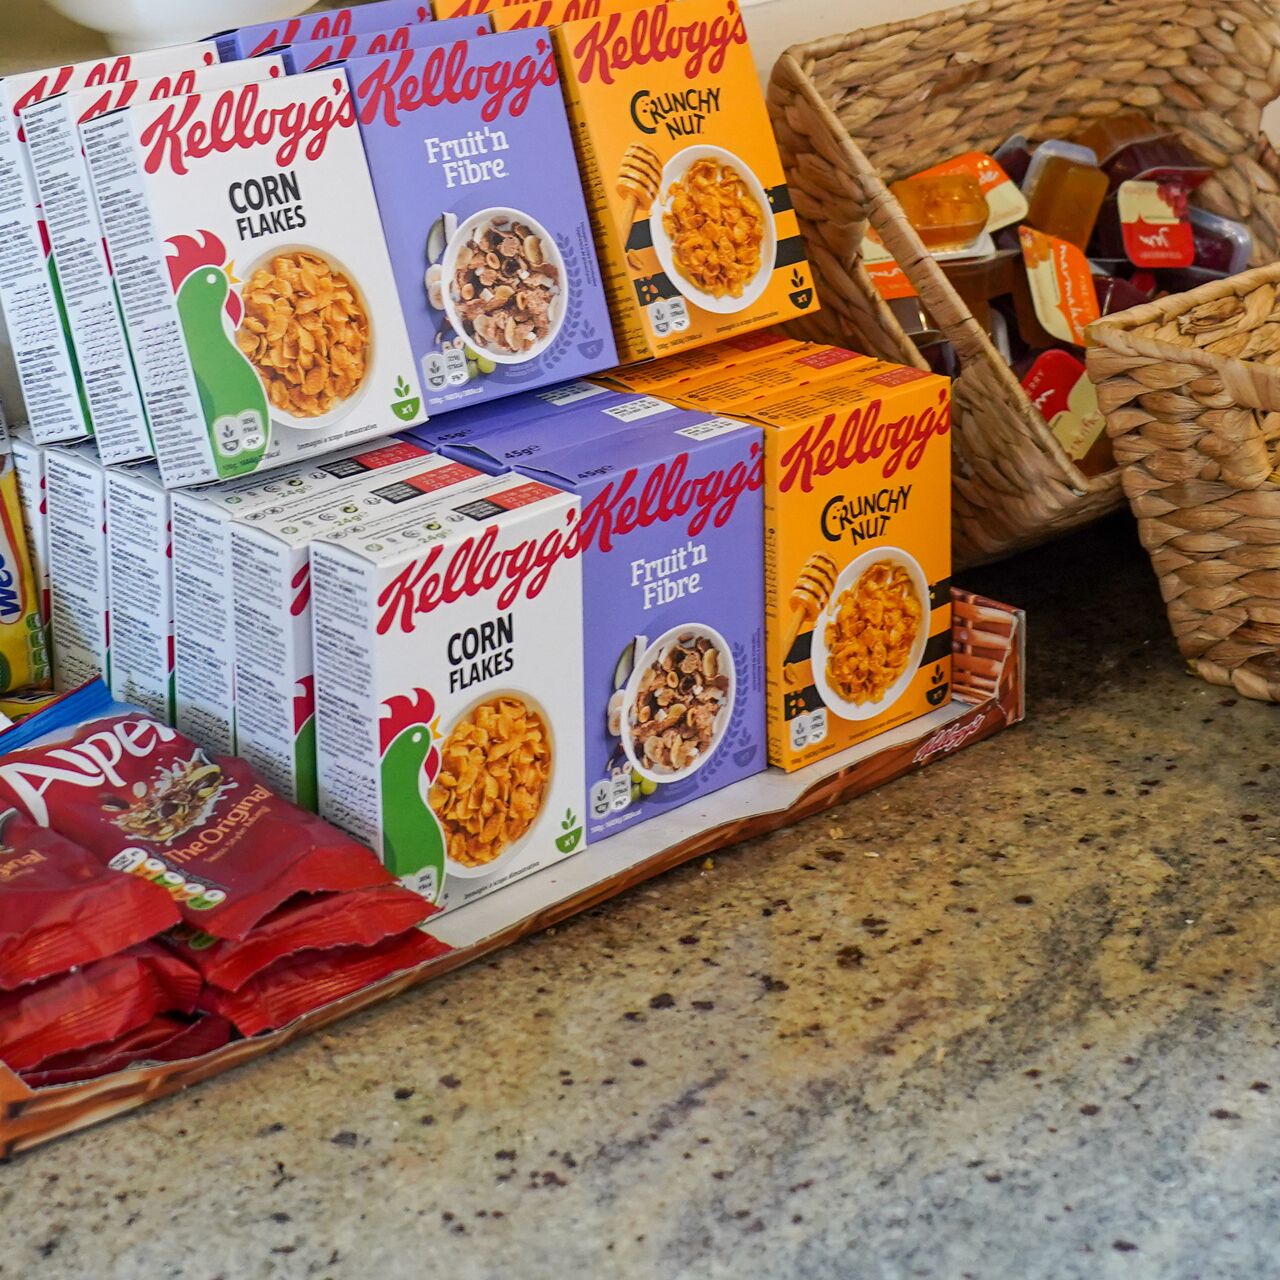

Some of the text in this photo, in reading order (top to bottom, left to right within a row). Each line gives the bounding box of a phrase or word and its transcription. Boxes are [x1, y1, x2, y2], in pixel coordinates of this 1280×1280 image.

[574, 0, 748, 85] Kellogg's
[357, 38, 560, 128] Kellogg's
[140, 78, 357, 176] Kellogg's
[630, 87, 720, 134] CRUNCHY
[666, 113, 705, 140] NUT
[424, 126, 509, 163] Fruit'n
[229, 170, 301, 215] CORN
[445, 155, 507, 188] Fibre
[236, 204, 307, 241] FLAKES
[505, 447, 532, 460] 45g
[778, 389, 951, 494] Kellogg's
[581, 442, 764, 552] Kellogg's
[821, 484, 913, 542] CRUNCHY
[851, 515, 889, 546] NUT
[376, 507, 583, 636] Kellogg's
[630, 541, 708, 588] Fruit'n
[643, 570, 702, 610] Fibre
[446, 613, 514, 665] CORN
[449, 648, 514, 694] FLAKES
[162, 783, 274, 864] The Original
